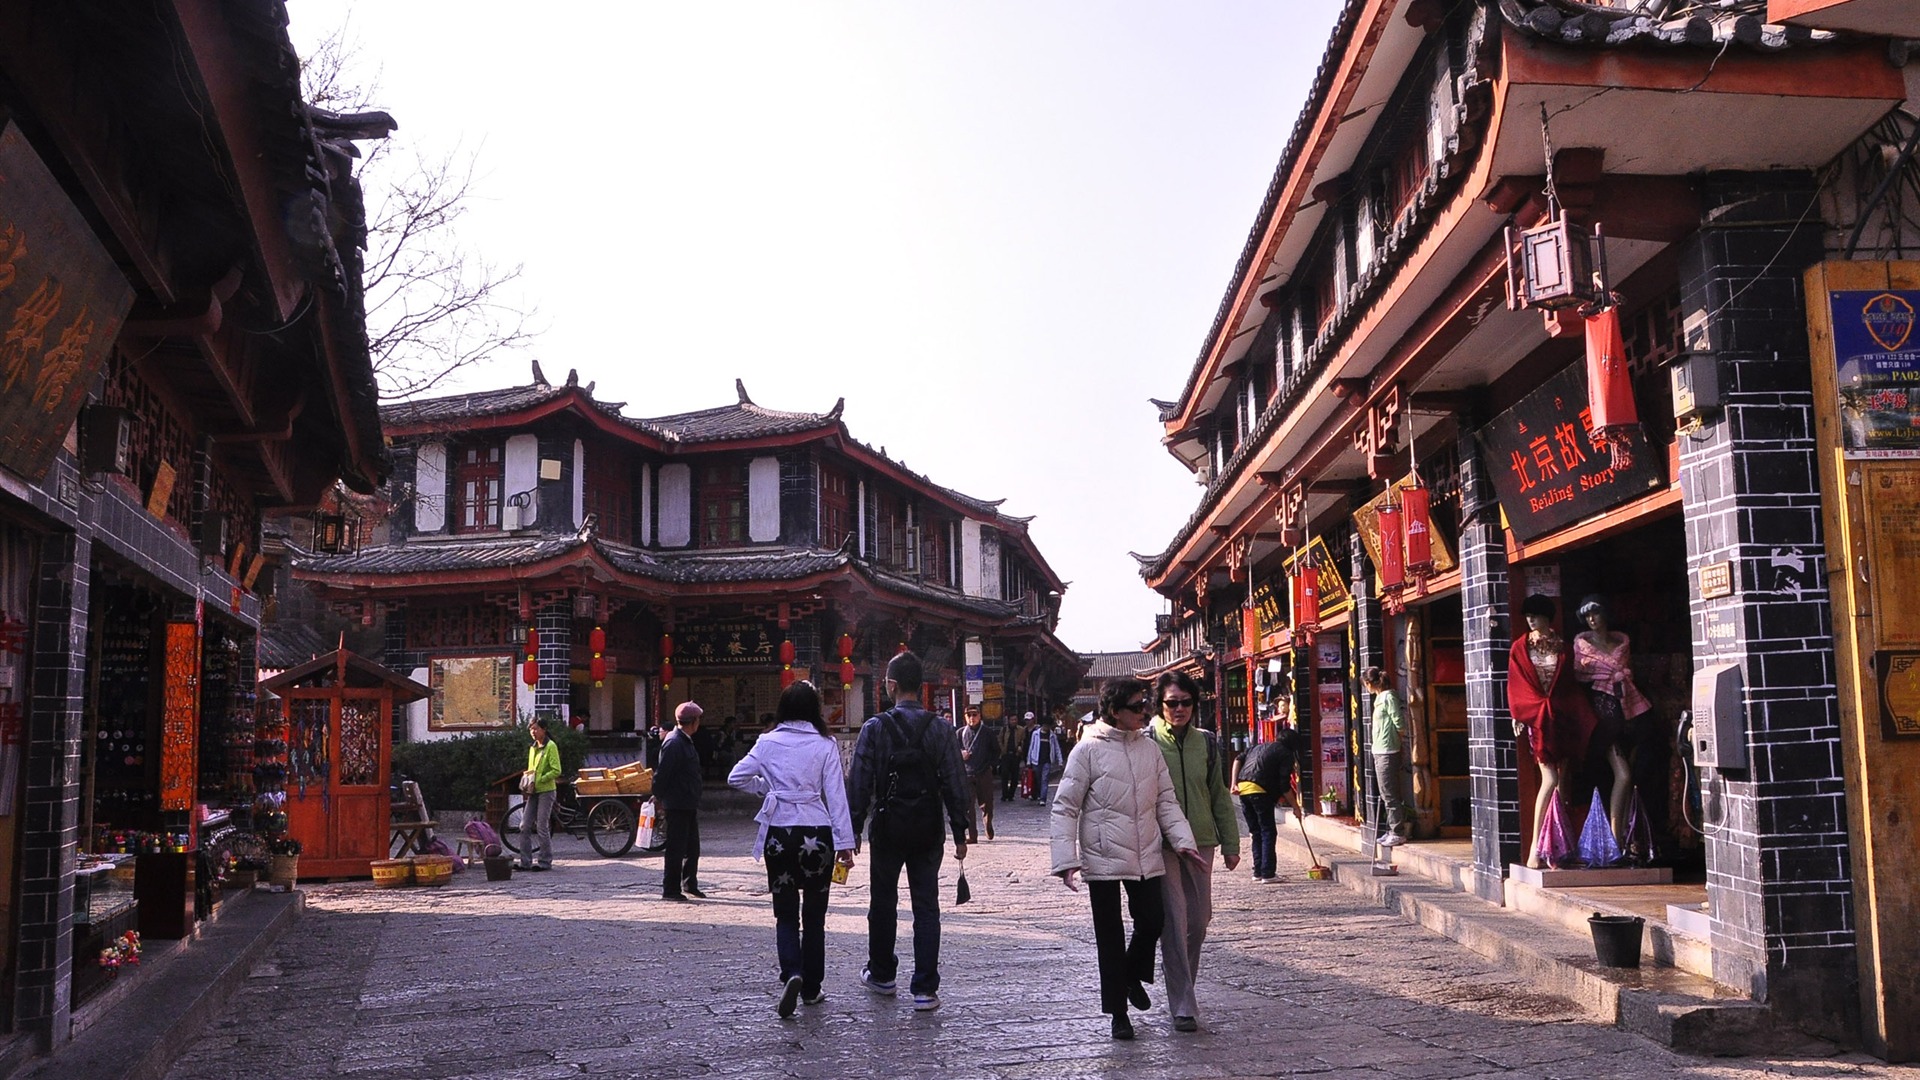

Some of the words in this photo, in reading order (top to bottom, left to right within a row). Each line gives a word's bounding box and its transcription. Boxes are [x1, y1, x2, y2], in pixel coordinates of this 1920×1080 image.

[1881, 323, 1906, 337] 110
[1892, 370, 1920, 382] PA02
[1529, 484, 1575, 514] BeiJing
[1579, 466, 1616, 492] Story
[705, 655, 773, 664] Restaurant
